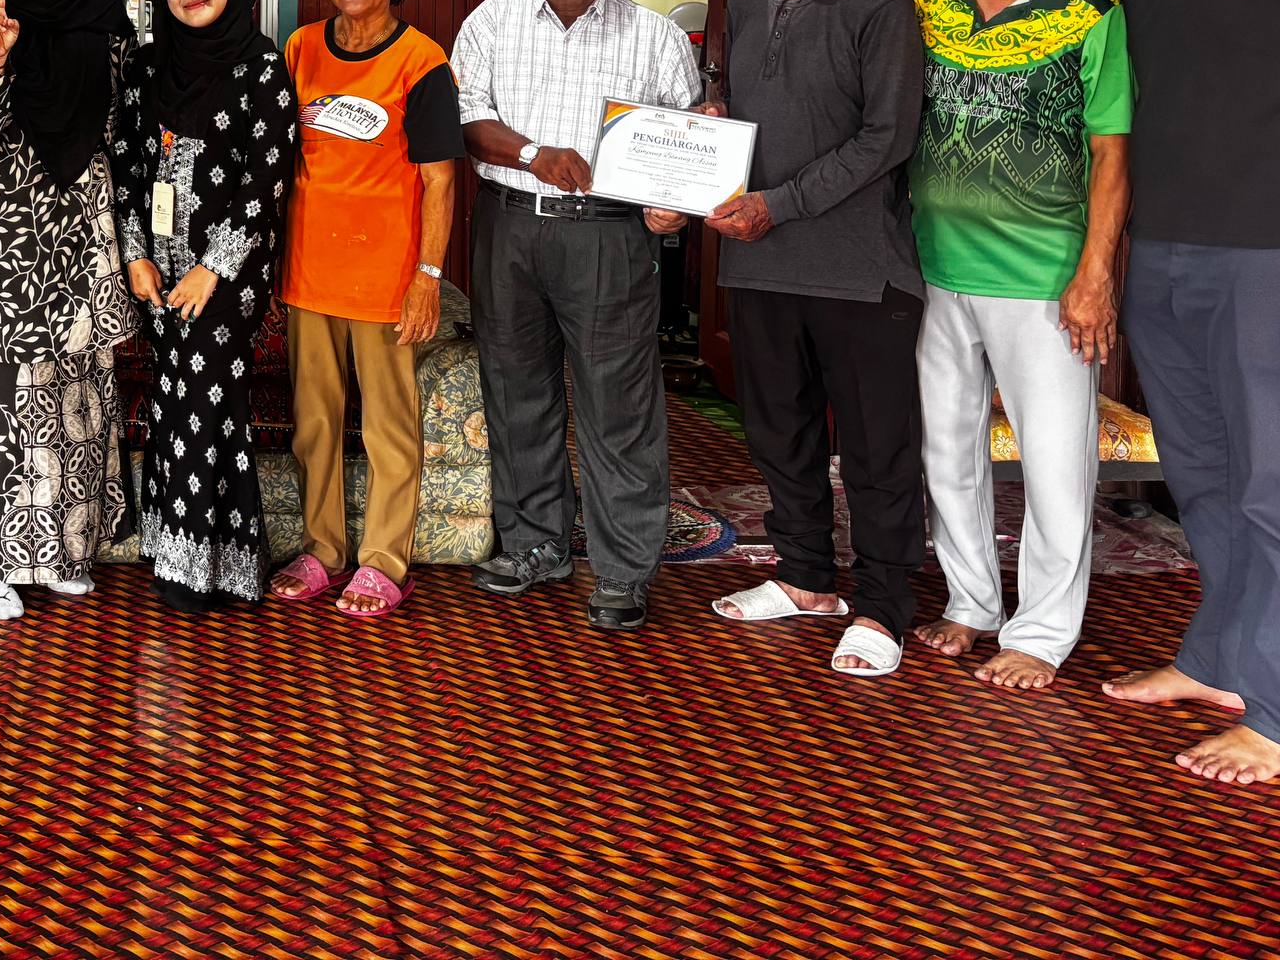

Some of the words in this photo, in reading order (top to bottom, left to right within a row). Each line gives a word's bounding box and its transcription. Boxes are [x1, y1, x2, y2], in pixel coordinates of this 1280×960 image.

[924, 64, 1027, 109] SARAWAK
[338, 102, 379, 122] MALAYSIA
[632, 132, 718, 155] PENGHARGAAN
[663, 128, 689, 140] SIJIL
